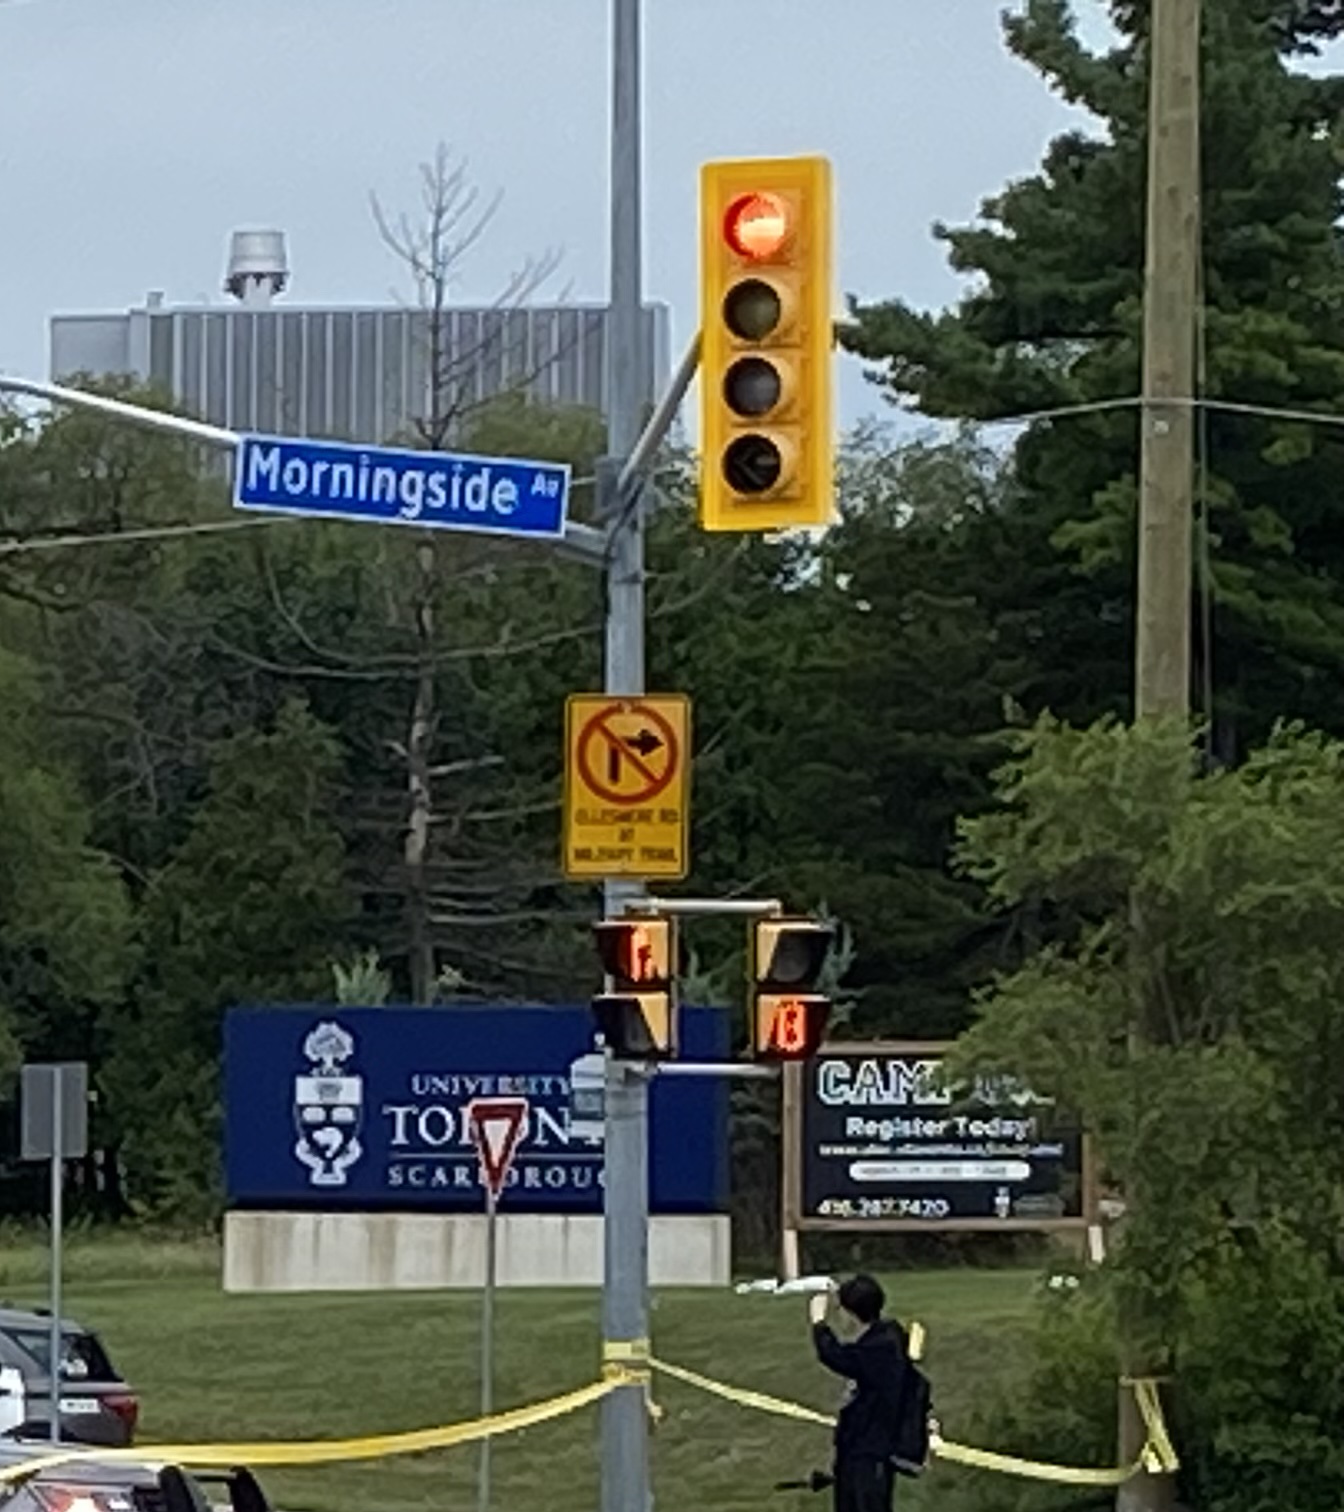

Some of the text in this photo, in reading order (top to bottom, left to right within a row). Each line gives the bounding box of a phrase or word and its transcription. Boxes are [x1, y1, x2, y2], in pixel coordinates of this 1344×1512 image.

[246, 444, 520, 518] Morningside
[412, 1074, 571, 1095] UNIVERSITY
[845, 1116, 946, 1141] Register
